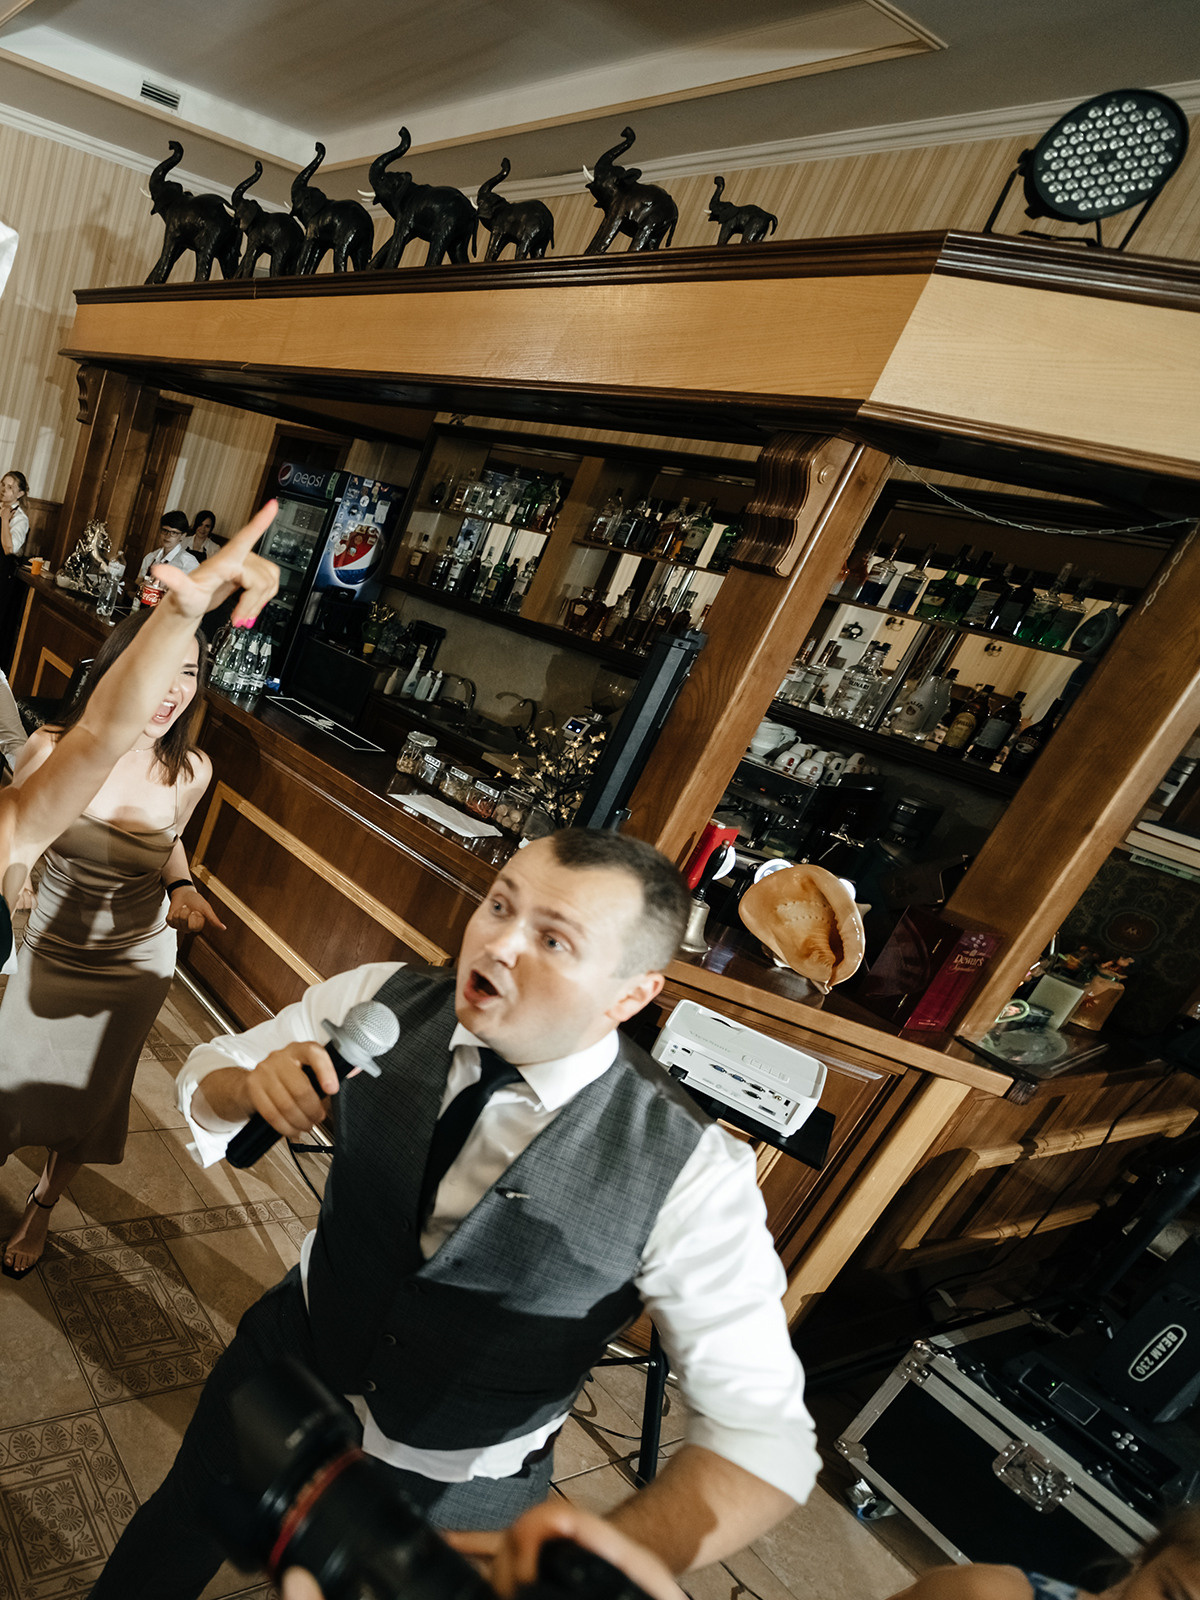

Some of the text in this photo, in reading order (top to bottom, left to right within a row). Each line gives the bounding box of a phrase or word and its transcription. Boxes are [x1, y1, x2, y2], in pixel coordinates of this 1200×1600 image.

[292, 471, 326, 488] pepsi
[1135, 1331, 1178, 1375] BEAM 230
